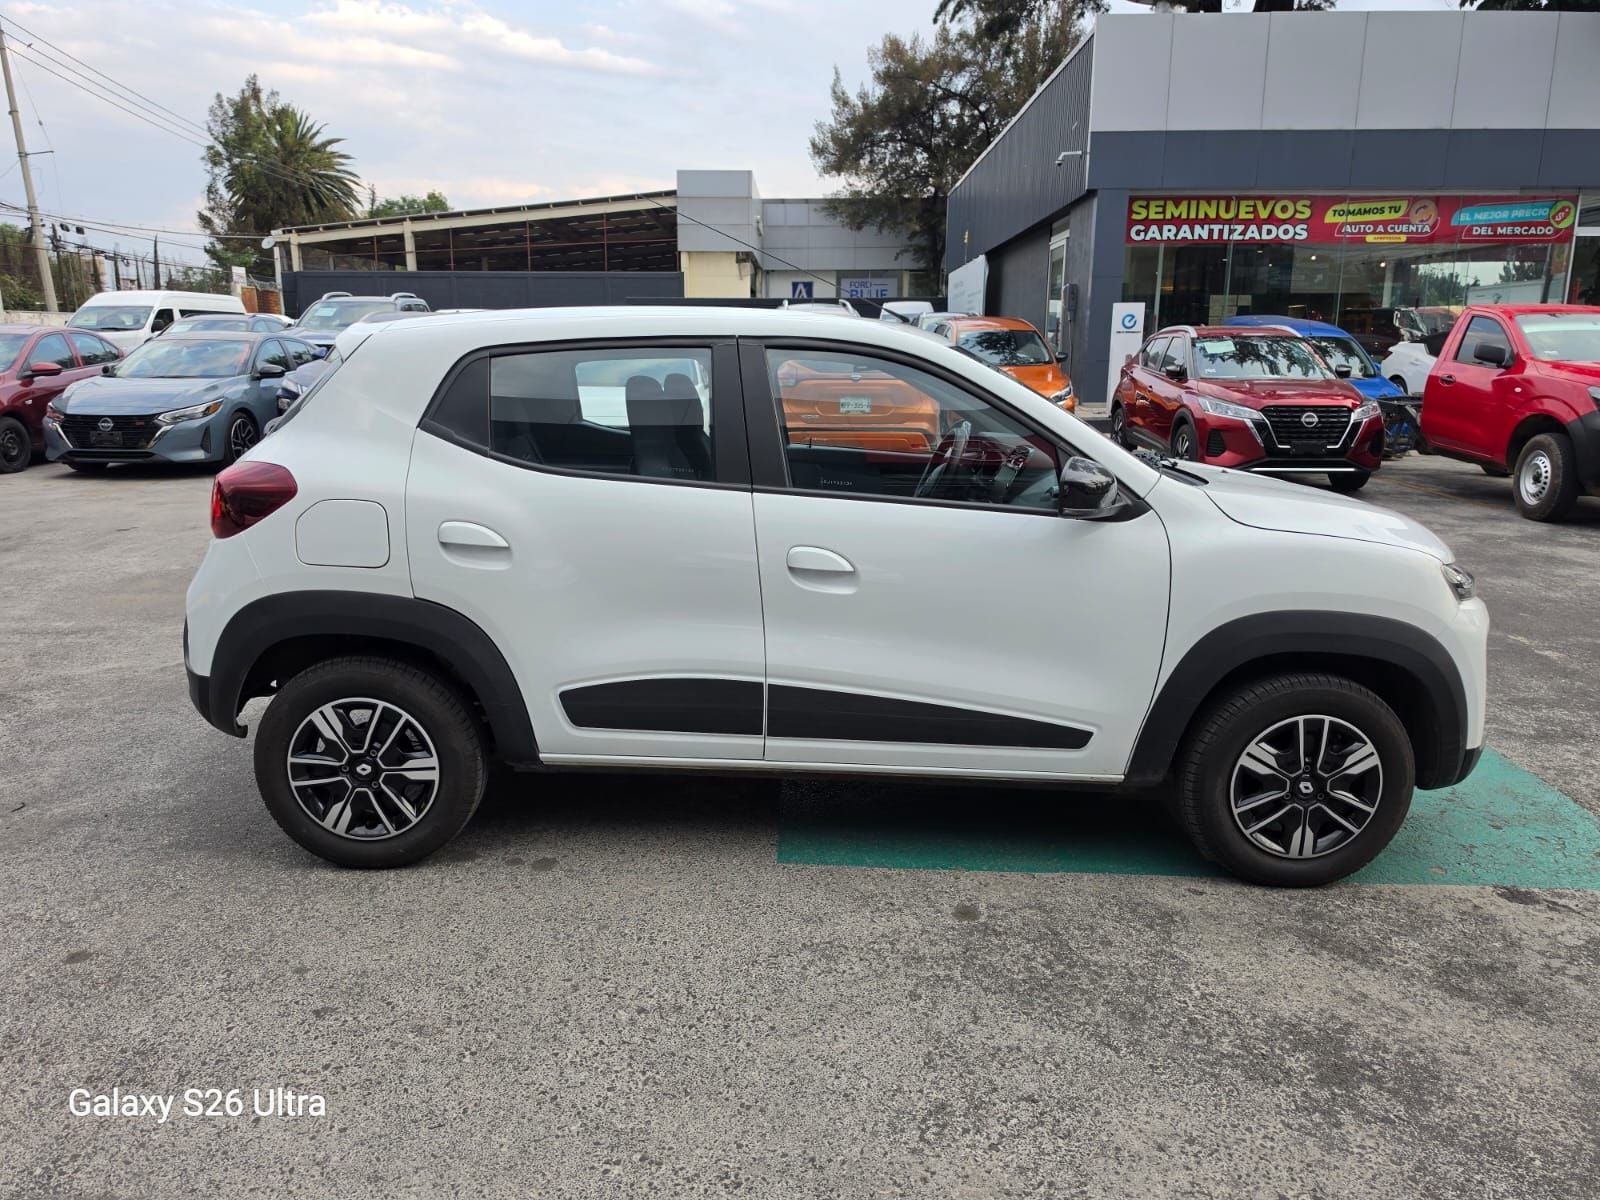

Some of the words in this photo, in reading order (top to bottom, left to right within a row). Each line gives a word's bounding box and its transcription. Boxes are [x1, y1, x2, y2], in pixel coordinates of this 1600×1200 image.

[1131, 199, 1312, 220] SEMINUEVOS
[1332, 206, 1386, 217] TOMAMOS
[1388, 205, 1402, 214] TU
[1459, 212, 1471, 221] EL
[1473, 210, 1510, 220] MEJOR
[1511, 208, 1550, 218] PRECIO
[1129, 223, 1308, 241] GARANTIZADOS
[1341, 224, 1374, 233] AUTO
[1376, 224, 1385, 233] A
[1387, 224, 1431, 233] CUENTA
[1472, 226, 1495, 235] DEL
[1496, 226, 1554, 235] MERCADO
[849, 280, 872, 289] FORD
